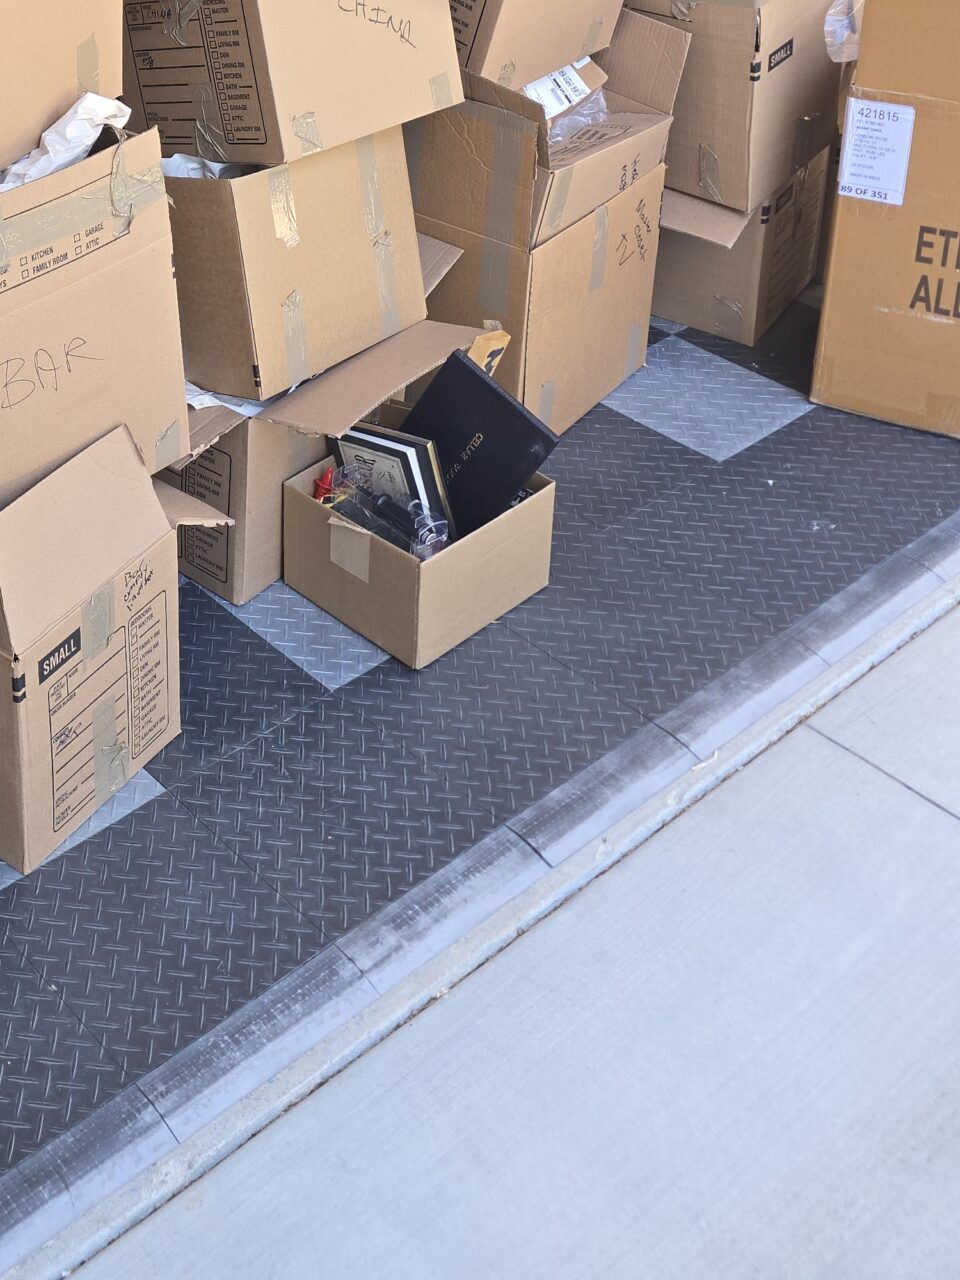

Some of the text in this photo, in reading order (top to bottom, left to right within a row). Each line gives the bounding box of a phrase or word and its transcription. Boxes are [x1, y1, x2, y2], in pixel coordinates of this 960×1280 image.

[770, 44, 791, 67] SMALL
[858, 107, 900, 122] 421815
[840, 185, 888, 200] 89 OF 351
[31, 222, 105, 261] KITCHEN GARAGE
[32, 260, 51, 275] FAMILY
[52, 252, 68, 267] ROOM
[85, 238, 100, 251] ATTIC
[43, 643, 77, 675] SMALL
